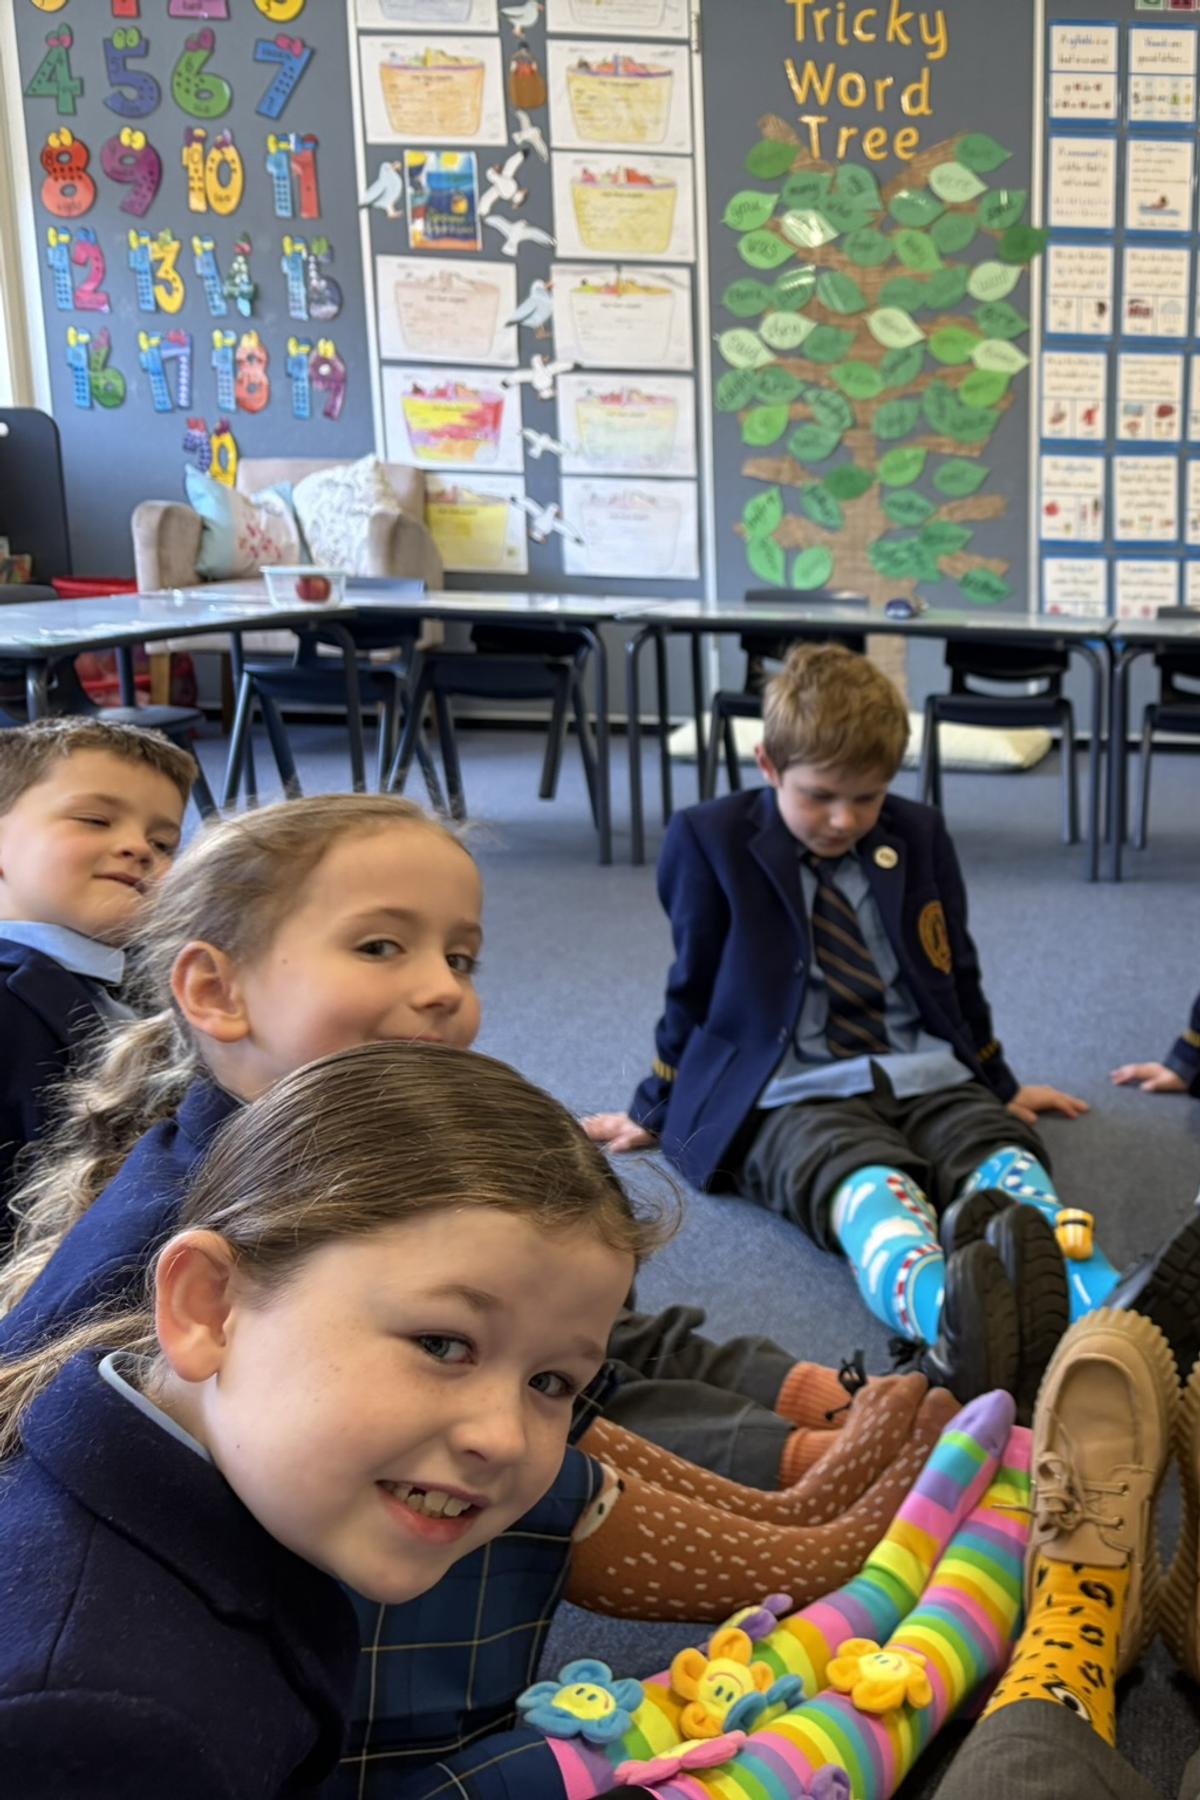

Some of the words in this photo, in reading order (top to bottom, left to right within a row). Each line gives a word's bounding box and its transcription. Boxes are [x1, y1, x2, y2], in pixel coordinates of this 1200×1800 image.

[785, 0, 948, 60] Tricky
[784, 58, 933, 117] Word
[799, 115, 919, 161] Tree
